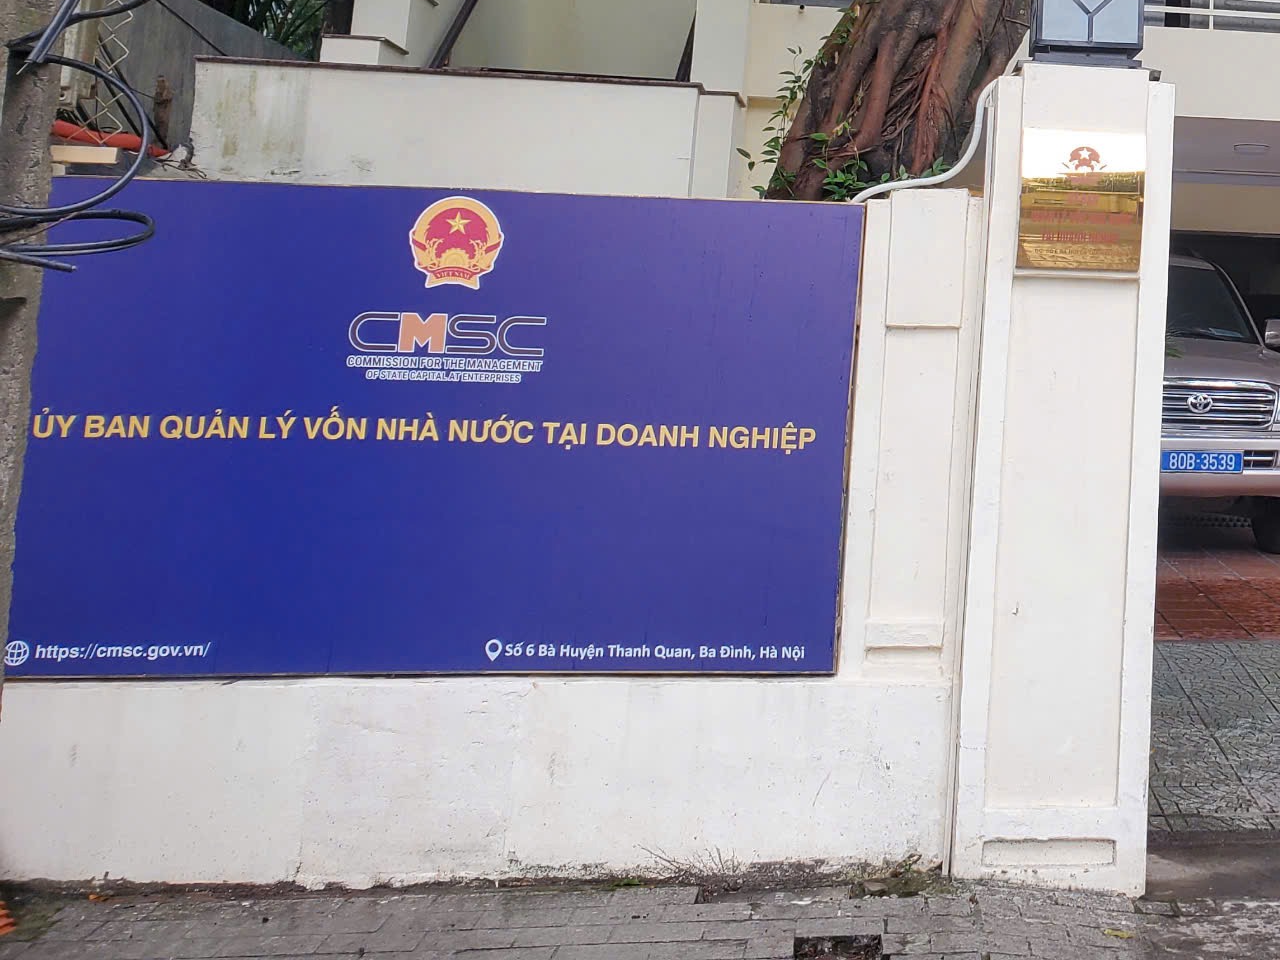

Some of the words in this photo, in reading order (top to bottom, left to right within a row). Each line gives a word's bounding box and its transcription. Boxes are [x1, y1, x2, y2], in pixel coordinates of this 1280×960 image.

[349, 311, 547, 357] CMSC
[346, 355, 418, 369] COMMISSION
[419, 357, 441, 369] FOR
[444, 357, 464, 370] THE
[466, 358, 543, 372] MANAGEMENT
[366, 369, 378, 379] OF
[379, 370, 409, 381] STATE
[409, 370, 447, 381] CAPITAL
[448, 371, 462, 382] AT
[462, 372, 521, 383] ENTERPRISES
[32, 407, 78, 438] ỦY
[83, 415, 150, 438] BAN
[159, 409, 249, 440] QUẢN
[258, 410, 295, 439] LÝ
[303, 406, 367, 440] VỐN
[376, 411, 439, 441] NHÀ
[447, 413, 534, 443] NƯỚC
[542, 421, 587, 450] TẠI
[596, 423, 700, 447] DOANH
[708, 421, 817, 454] NGHIỆP
[1169, 452, 1236, 470] 80B-3539
[35, 642, 211, 661] https://cmsc.gov.vn/
[504, 641, 523, 657] Số
[526, 643, 535, 657] 6
[538, 643, 555, 657] Bà
[560, 643, 604, 660] Huyện
[608, 644, 650, 658] Thanh
[654, 645, 696, 660] Quan,
[700, 646, 716, 658] Ba
[720, 644, 755, 661] Đình,
[759, 645, 777, 659] Hà
[782, 644, 805, 662] Nội
